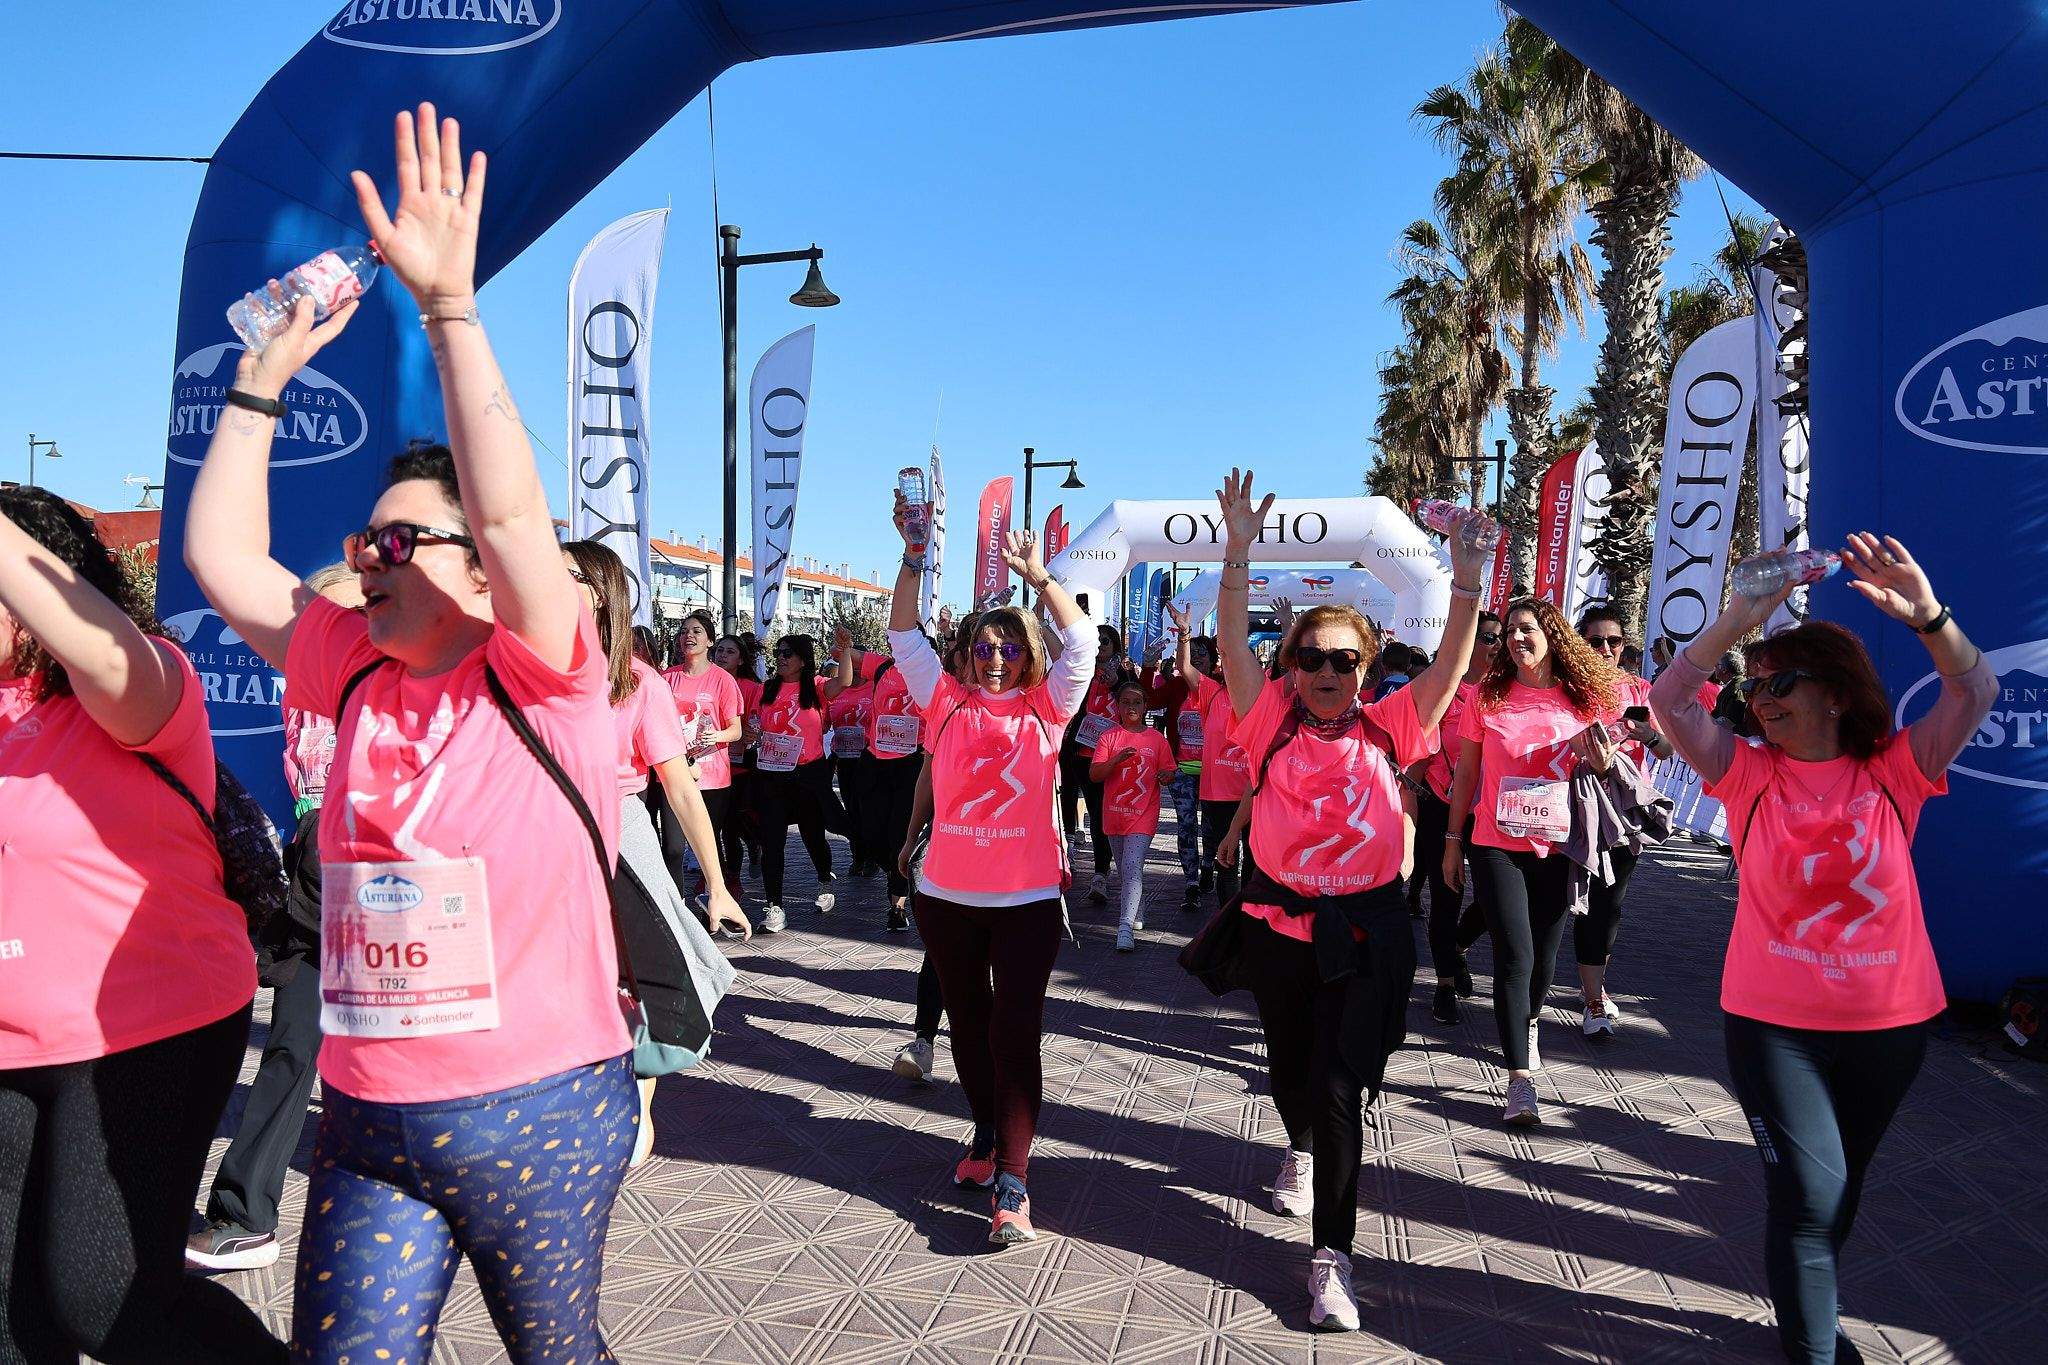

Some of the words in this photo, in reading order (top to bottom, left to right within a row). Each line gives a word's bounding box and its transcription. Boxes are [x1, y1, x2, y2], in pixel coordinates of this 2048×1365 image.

[179, 386, 228, 399] CENTRA
[284, 389, 339, 408] HERA
[1660, 371, 1744, 643] OYSHO
[1163, 512, 1328, 545] OYHO
[1546, 480, 1572, 585] Santander
[984, 500, 1002, 588] Santander
[1069, 549, 1117, 560] OYSHO
[1376, 546, 1429, 559] OYSHO
[890, 731, 906, 739] 016
[1522, 805, 1549, 817] 016
[939, 823, 974, 837] CARRERA
[975, 826, 987, 837] DE
[988, 827, 998, 838] LA
[1000, 827, 1026, 838] MUJER
[975, 838, 990, 847] 2025
[1279, 871, 1316, 886] CARRERA
[1318, 875, 1331, 887] DE
[1332, 875, 1344, 887] LA
[361, 889, 419, 904] ASTURIANA
[364, 942, 429, 969] 016
[1821, 953, 1837, 966] DE
[1823, 967, 1847, 980] 2025
[378, 978, 408, 990] 1792
[366, 994, 378, 1005] DE
[379, 994, 389, 1005] LA
[425, 989, 470, 1002] VALENCIA
[337, 1012, 380, 1027] OYSHO
[414, 1010, 474, 1026] Santander
